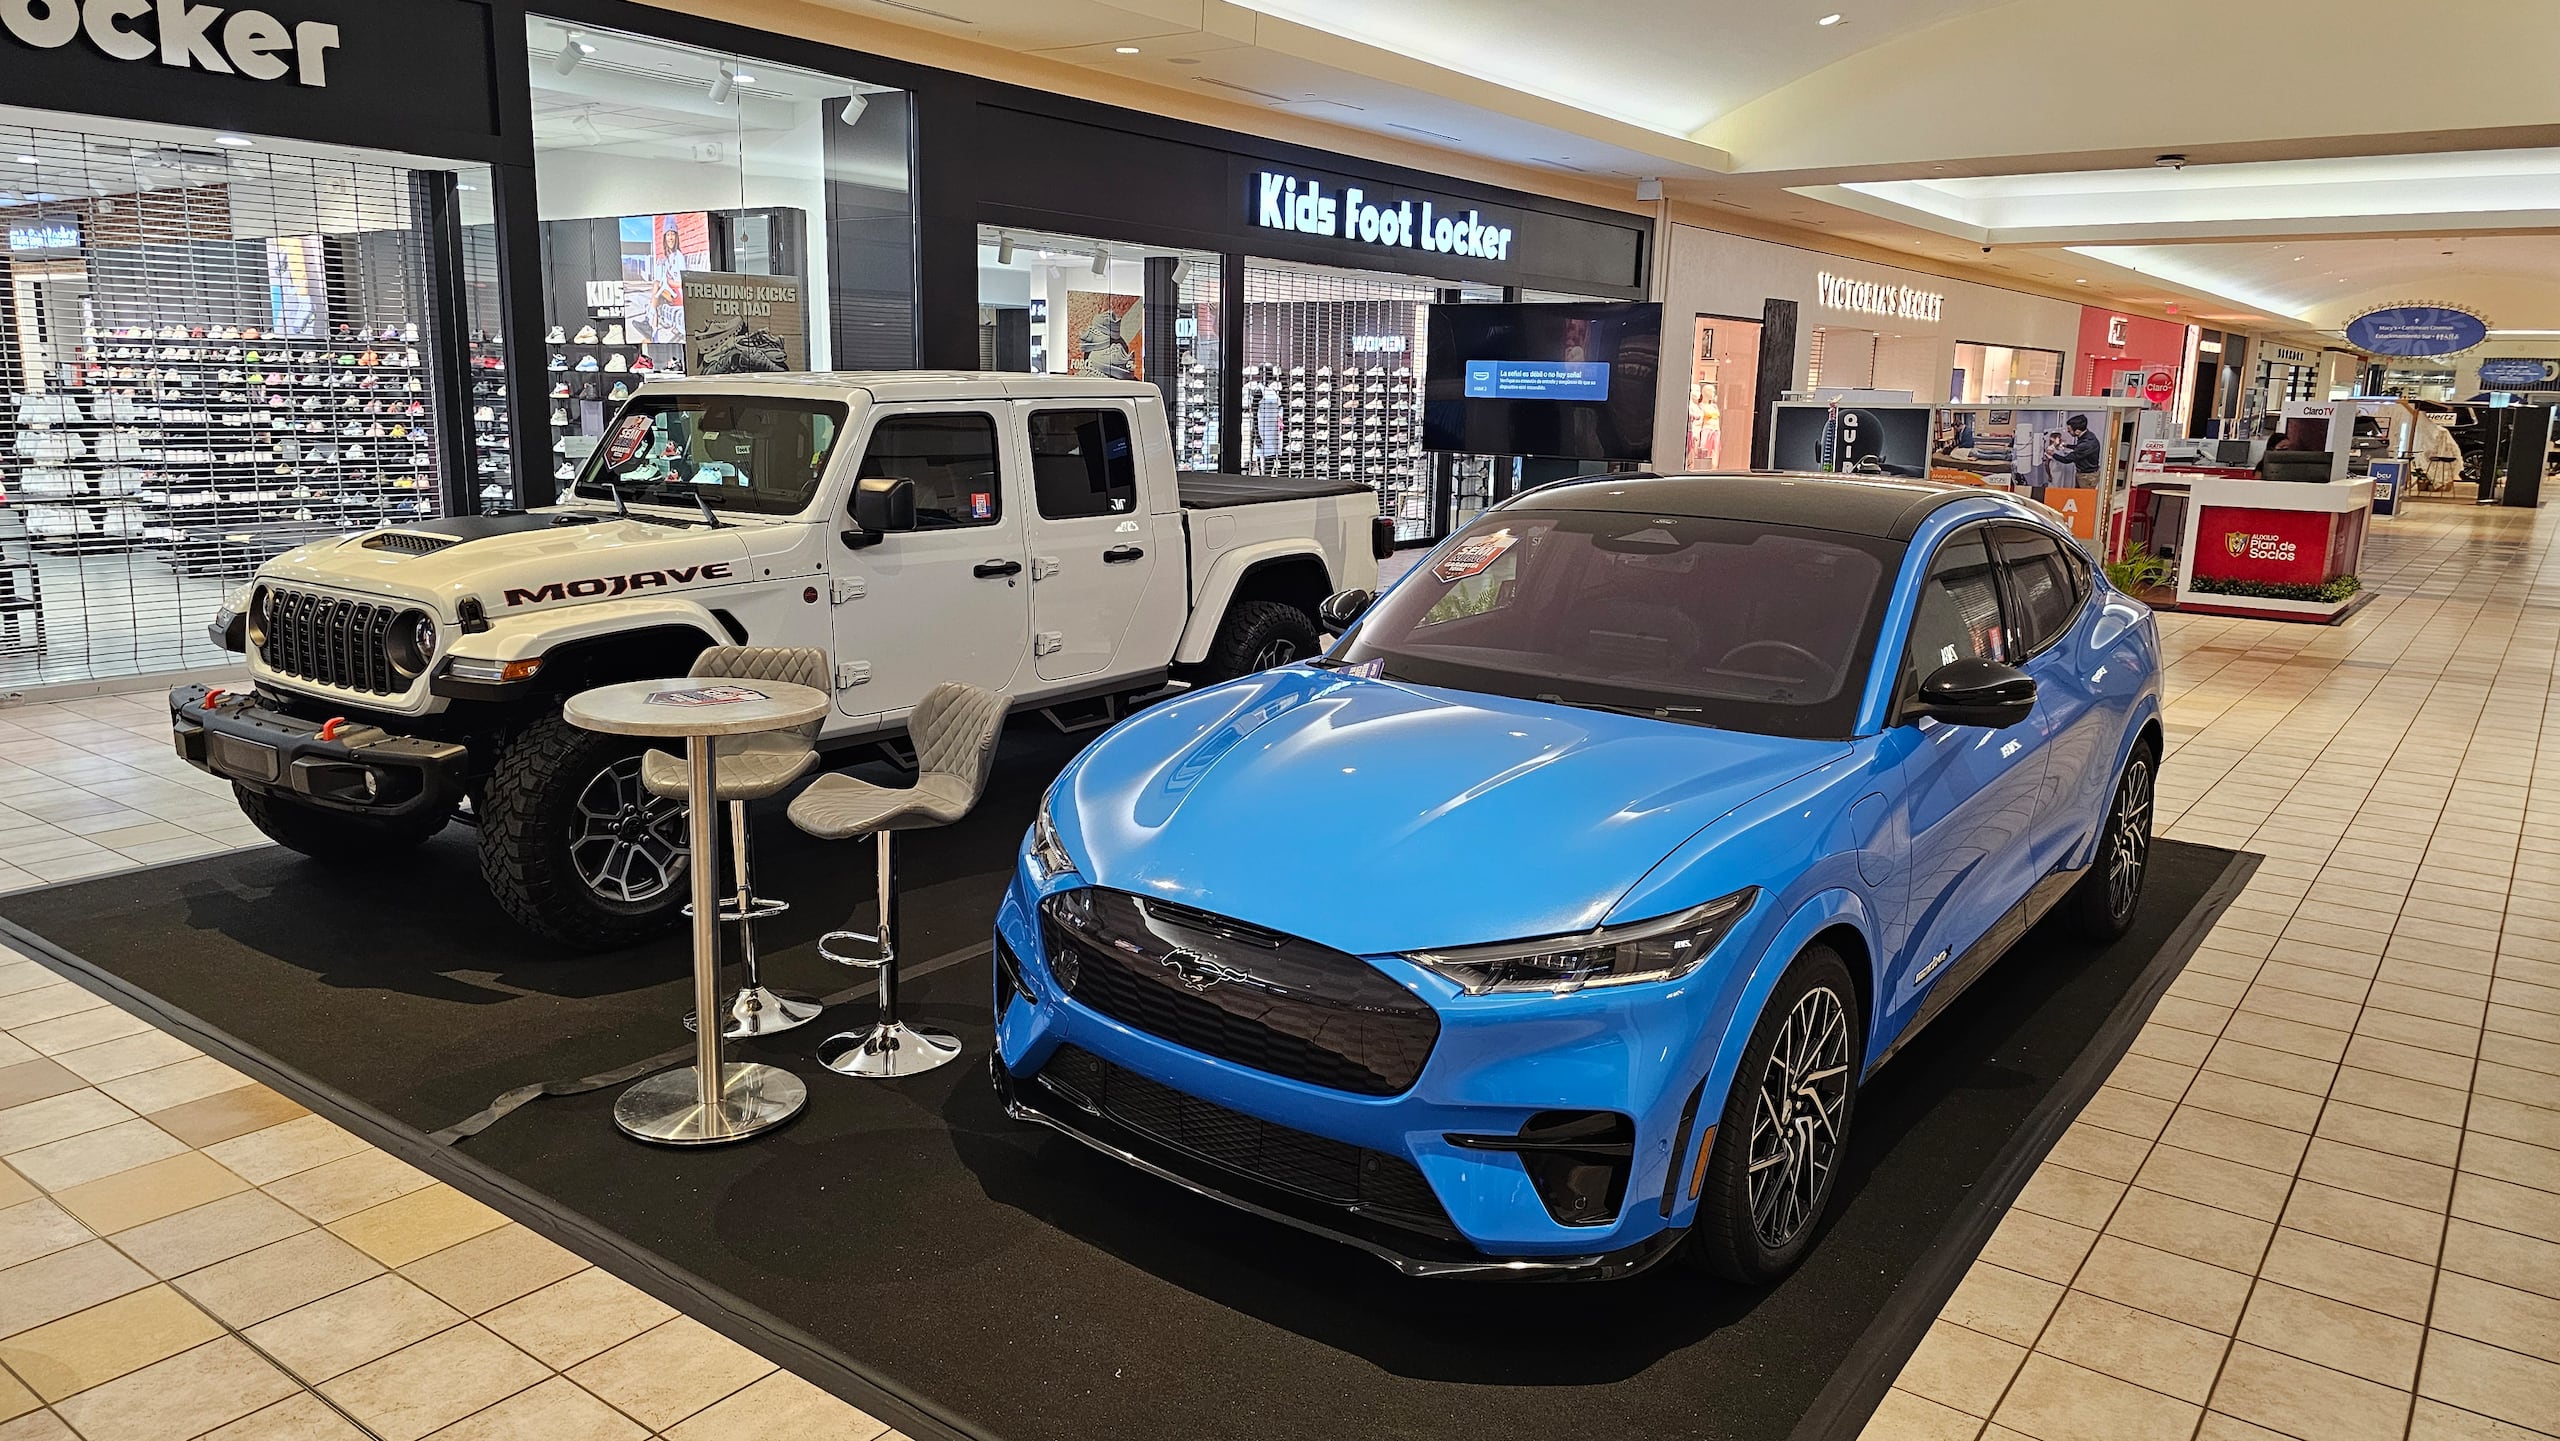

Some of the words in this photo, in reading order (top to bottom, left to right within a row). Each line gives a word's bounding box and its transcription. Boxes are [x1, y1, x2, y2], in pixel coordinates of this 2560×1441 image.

[1259, 171, 1337, 236] Kids
[1345, 188, 1413, 248] Foot
[1421, 201, 1512, 261] Locker
[586, 281, 625, 307] KIDS
[685, 282, 754, 301] TRENDING
[756, 286, 796, 302] KICKS
[1818, 271, 1898, 316] VICTORIA'S
[1898, 284, 1944, 322] SECRET
[713, 301, 741, 316] FOR
[743, 302, 771, 317] DAD
[1352, 335, 1406, 352] WOMEN
[1530, 370, 1543, 378] débil
[1556, 371, 1566, 379] hay
[1567, 371, 1582, 379] señal
[2146, 382, 2169, 391] Claro
[1457, 546, 1498, 556] SEMI
[2250, 540, 2276, 550] Plan
[2279, 541, 2297, 551] de
[2249, 548, 2295, 561] Socios
[503, 562, 733, 607] MOJAVE
